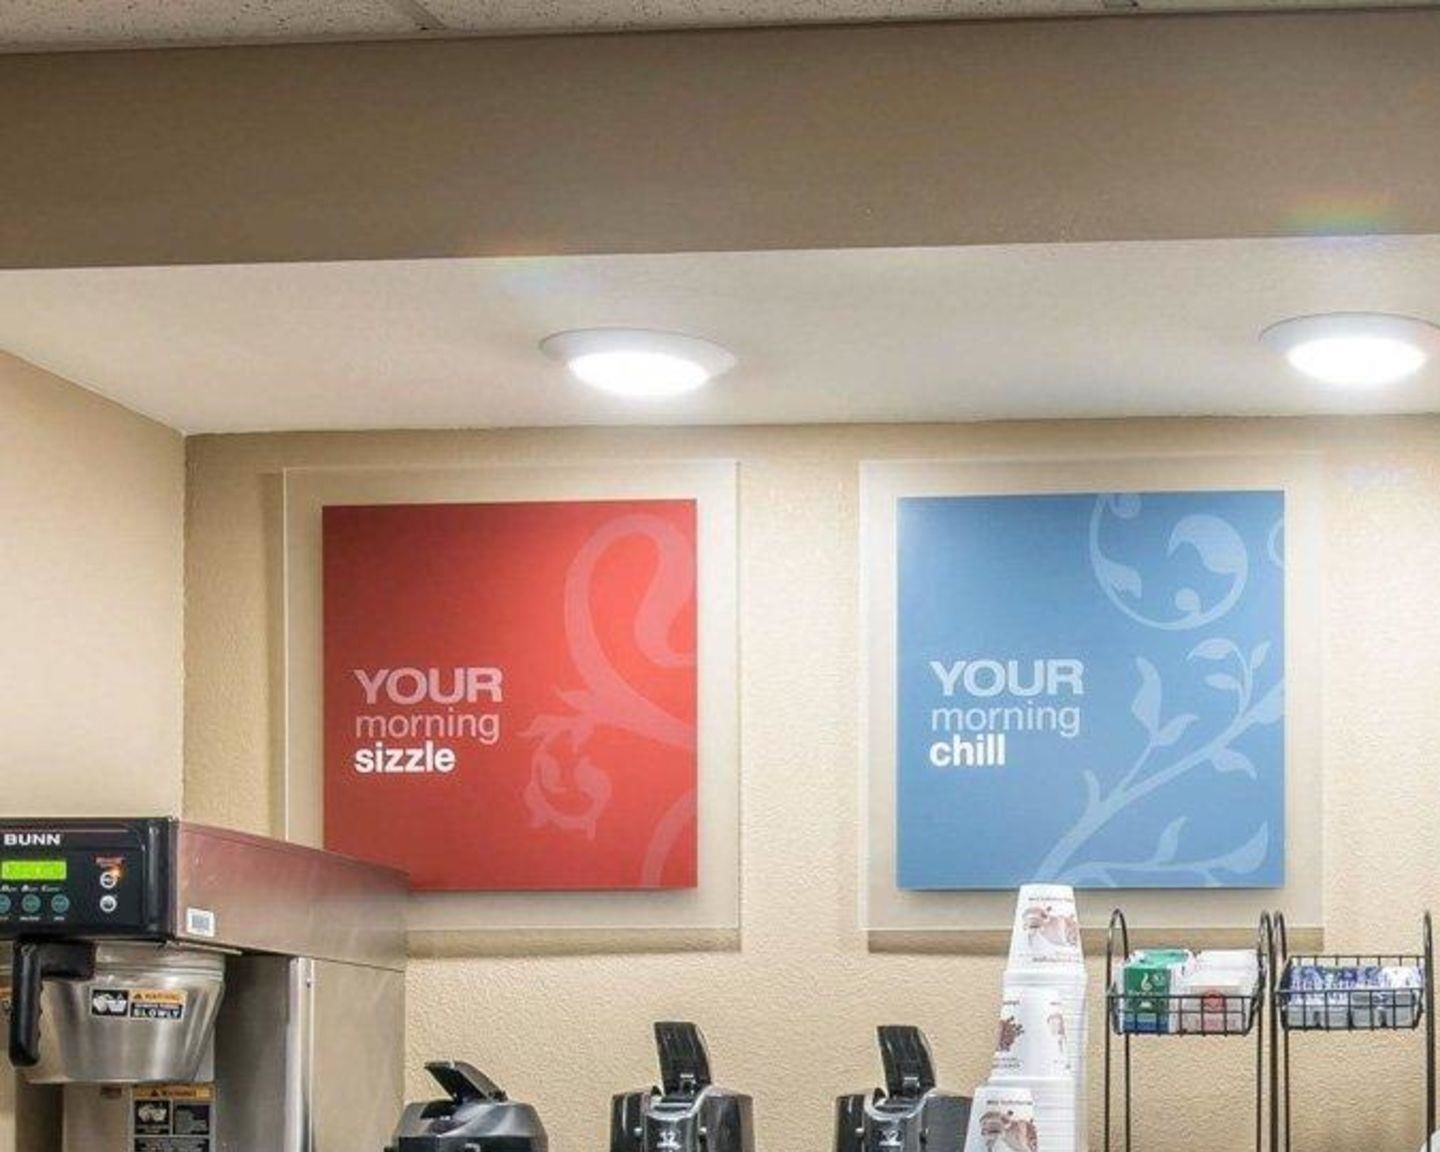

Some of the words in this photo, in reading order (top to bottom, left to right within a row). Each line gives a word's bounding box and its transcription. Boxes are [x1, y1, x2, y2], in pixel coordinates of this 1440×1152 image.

[353, 667, 503, 704] YOUR
[929, 659, 1084, 697] YOUR
[355, 706, 500, 745] morning
[931, 701, 1081, 738] morning
[354, 740, 456, 773] sizzle
[929, 733, 1006, 768] chill
[3, 833, 61, 846] BUNN
